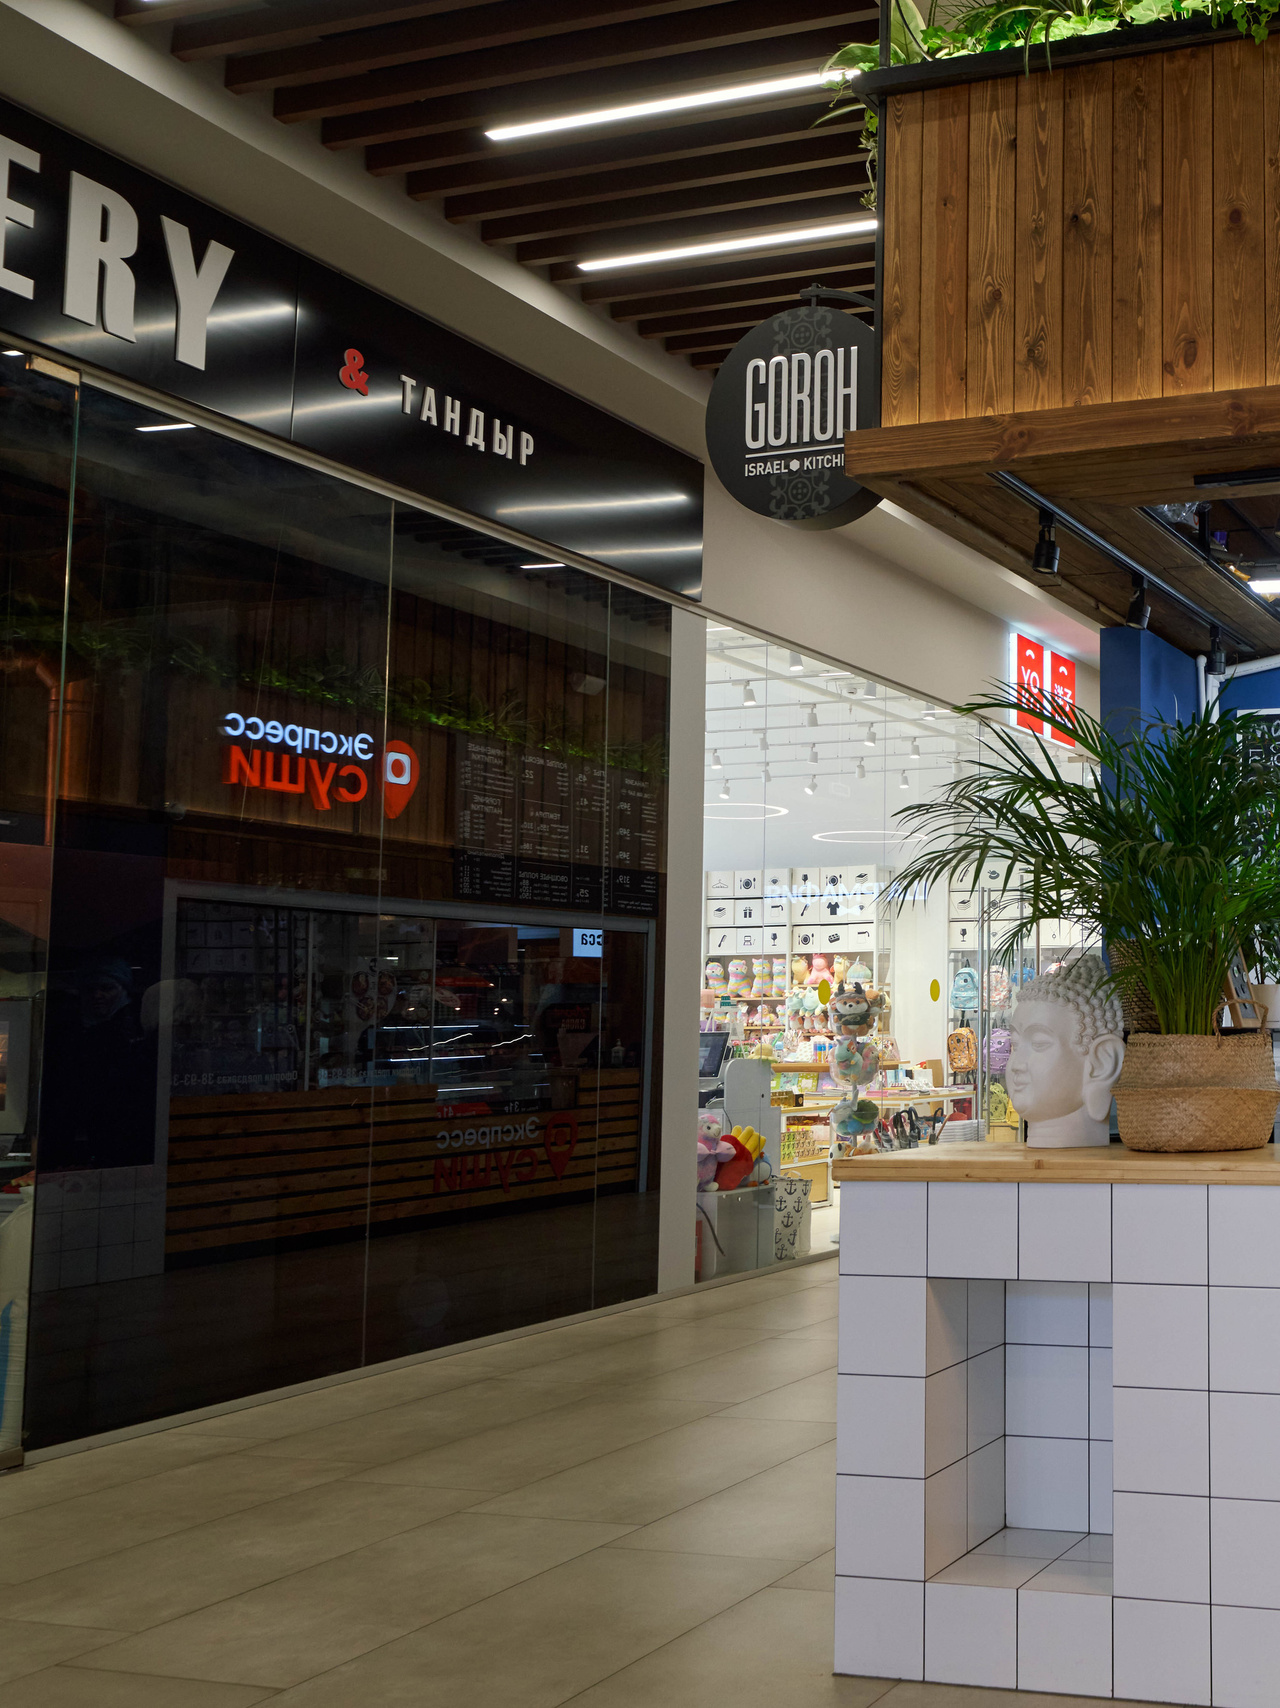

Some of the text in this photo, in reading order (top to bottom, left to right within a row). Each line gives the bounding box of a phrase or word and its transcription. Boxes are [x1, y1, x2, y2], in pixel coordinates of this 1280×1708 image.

[400, 374, 535, 466] ТАНДЫР
[745, 346, 858, 449] GOROH
[744, 453, 844, 477] ISRAEL KITCH
